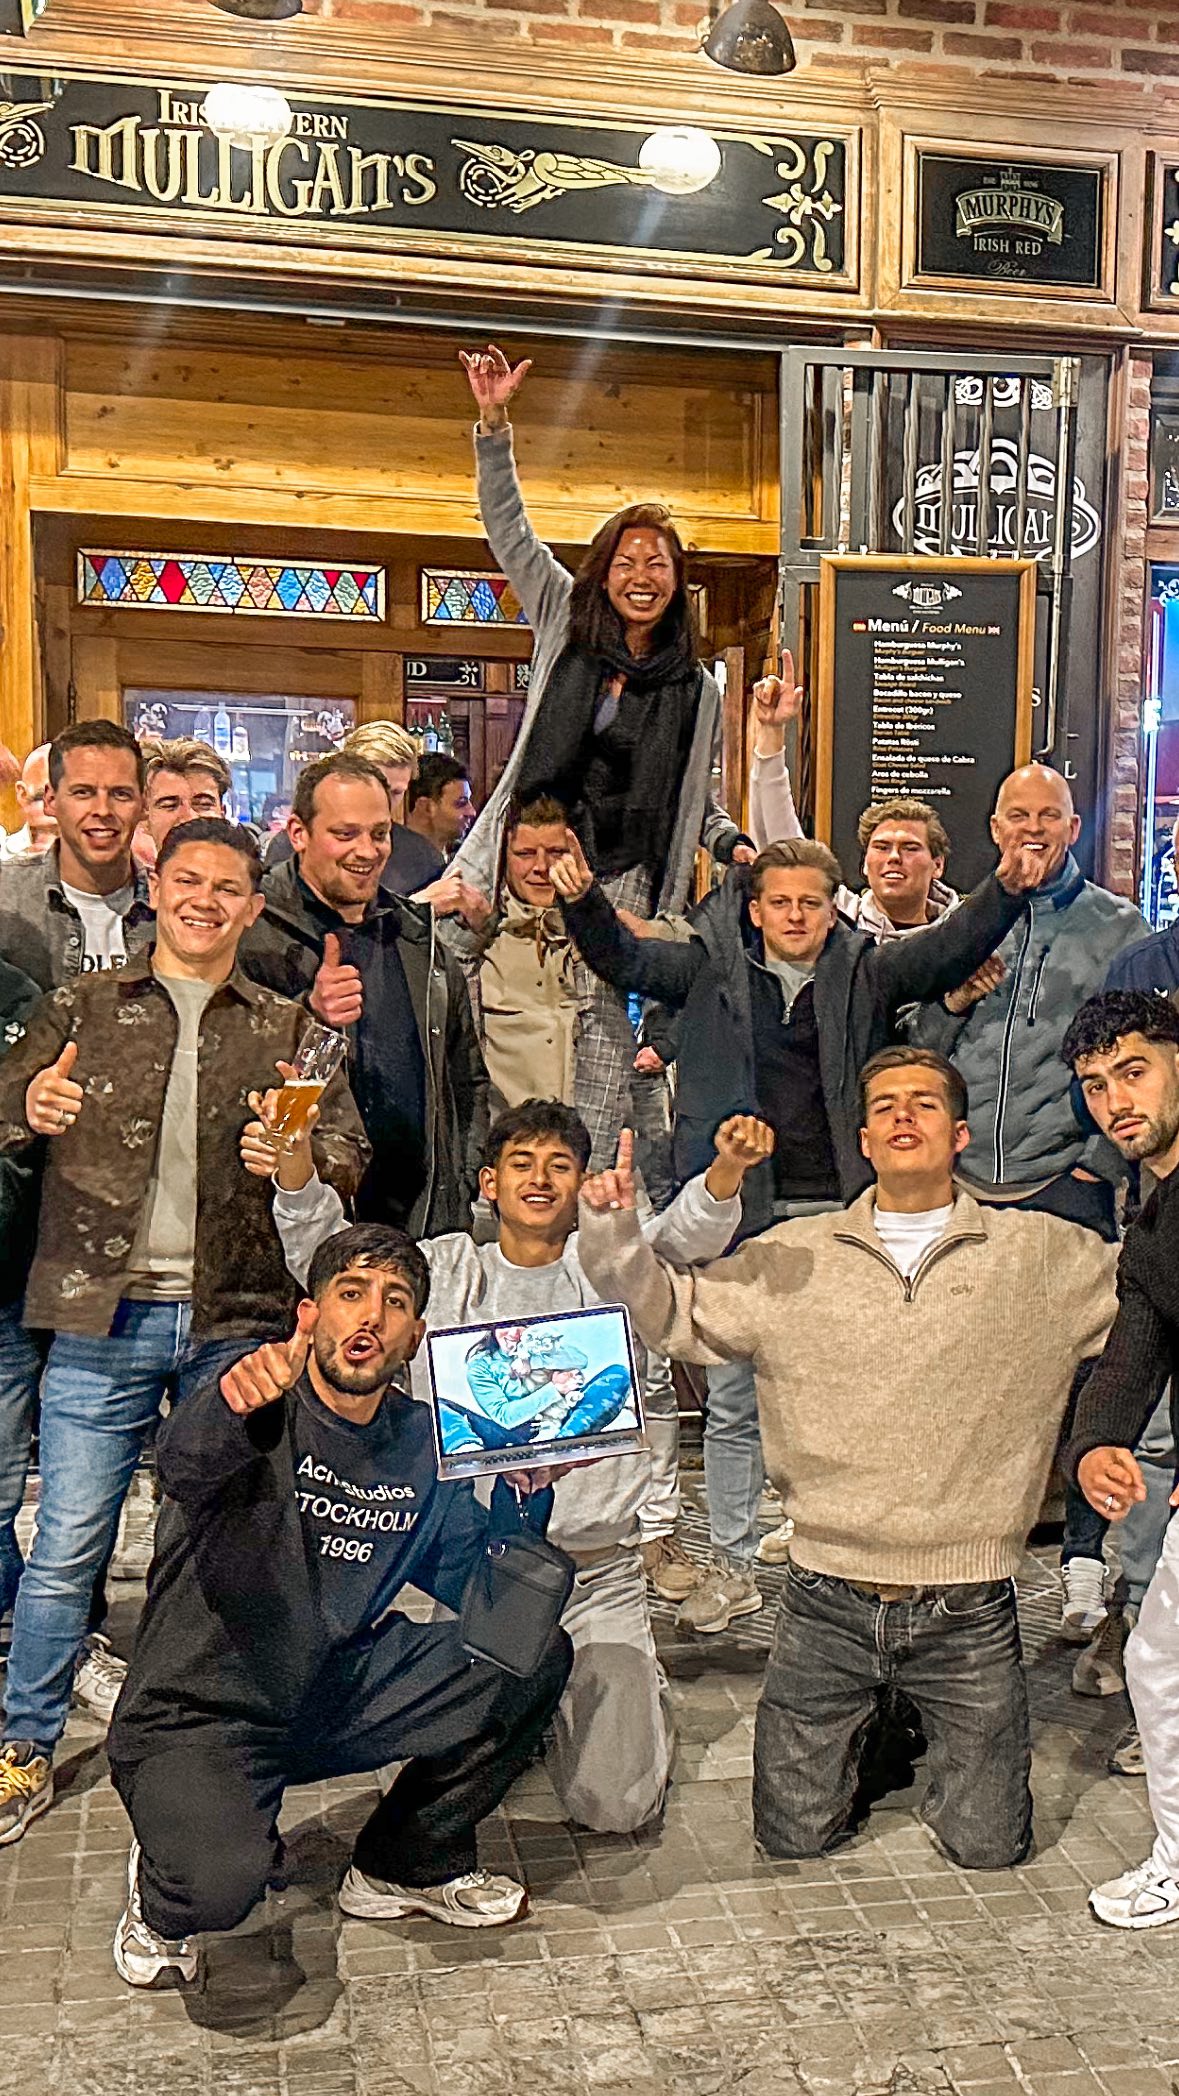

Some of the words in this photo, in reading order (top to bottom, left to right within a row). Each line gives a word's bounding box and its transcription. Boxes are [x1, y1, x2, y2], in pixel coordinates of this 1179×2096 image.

[973, 236, 1010, 253] IRISH
[1015, 241, 1042, 255] RED
[868, 619, 909, 633] Menú
[922, 622, 951, 633] Food
[954, 624, 986, 634] Menu
[907, 674, 944, 682] salchichas
[873, 689, 908, 698] Bocadillo
[909, 690, 932, 698] bacon
[873, 721, 894, 729] Tabla
[895, 721, 905, 729] de
[872, 738, 900, 746] Patatas
[872, 753, 905, 762] Ensalada
[906, 754, 917, 762] de
[917, 756, 940, 764] queso
[941, 755, 952, 763] de
[952, 756, 975, 764] Cabra
[871, 769, 890, 778] Aros
[889, 770, 901, 778] de
[901, 770, 929, 779] cebolla
[870, 786, 899, 795] Fingers
[899, 786, 910, 795] de
[294, 1490, 420, 1532] TOCKHOLM
[319, 1534, 374, 1563] 1996
